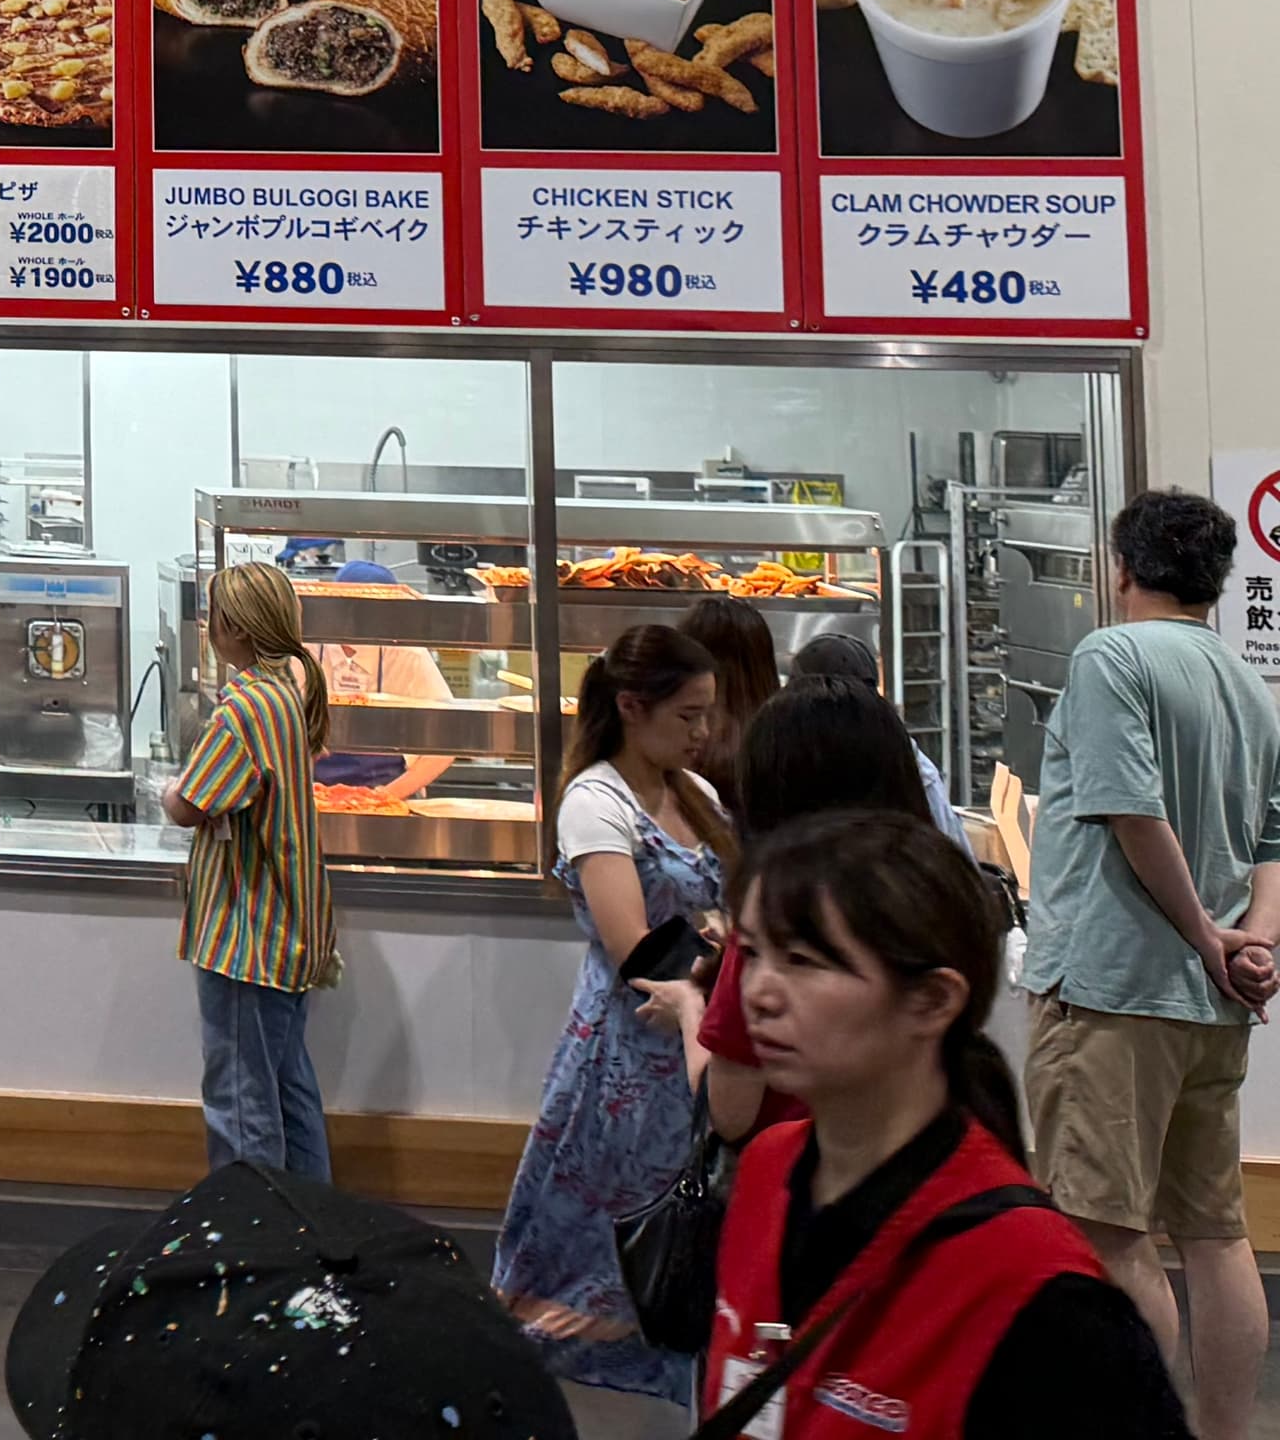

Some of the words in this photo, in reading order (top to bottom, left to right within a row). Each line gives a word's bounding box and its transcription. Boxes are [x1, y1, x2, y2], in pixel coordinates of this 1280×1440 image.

[0, 182, 38, 201] ピザ
[165, 187, 244, 205] JUMBO
[254, 188, 357, 207] BULGOGI
[366, 190, 429, 208] BAKE
[533, 188, 647, 208] CHICKEN
[657, 190, 733, 209] STICK
[832, 194, 901, 212] CLAM
[909, 194, 1039, 213] CHOWDER
[1046, 195, 1116, 213] SOUP
[58, 213, 85, 221] ホール
[167, 215, 427, 242] ジャンボプルコギベイク
[518, 216, 743, 244] チキンスティック
[858, 223, 1090, 248] クラムチャウダー
[1245, 576, 1273, 601] 売
[1246, 605, 1280, 631] 飲
